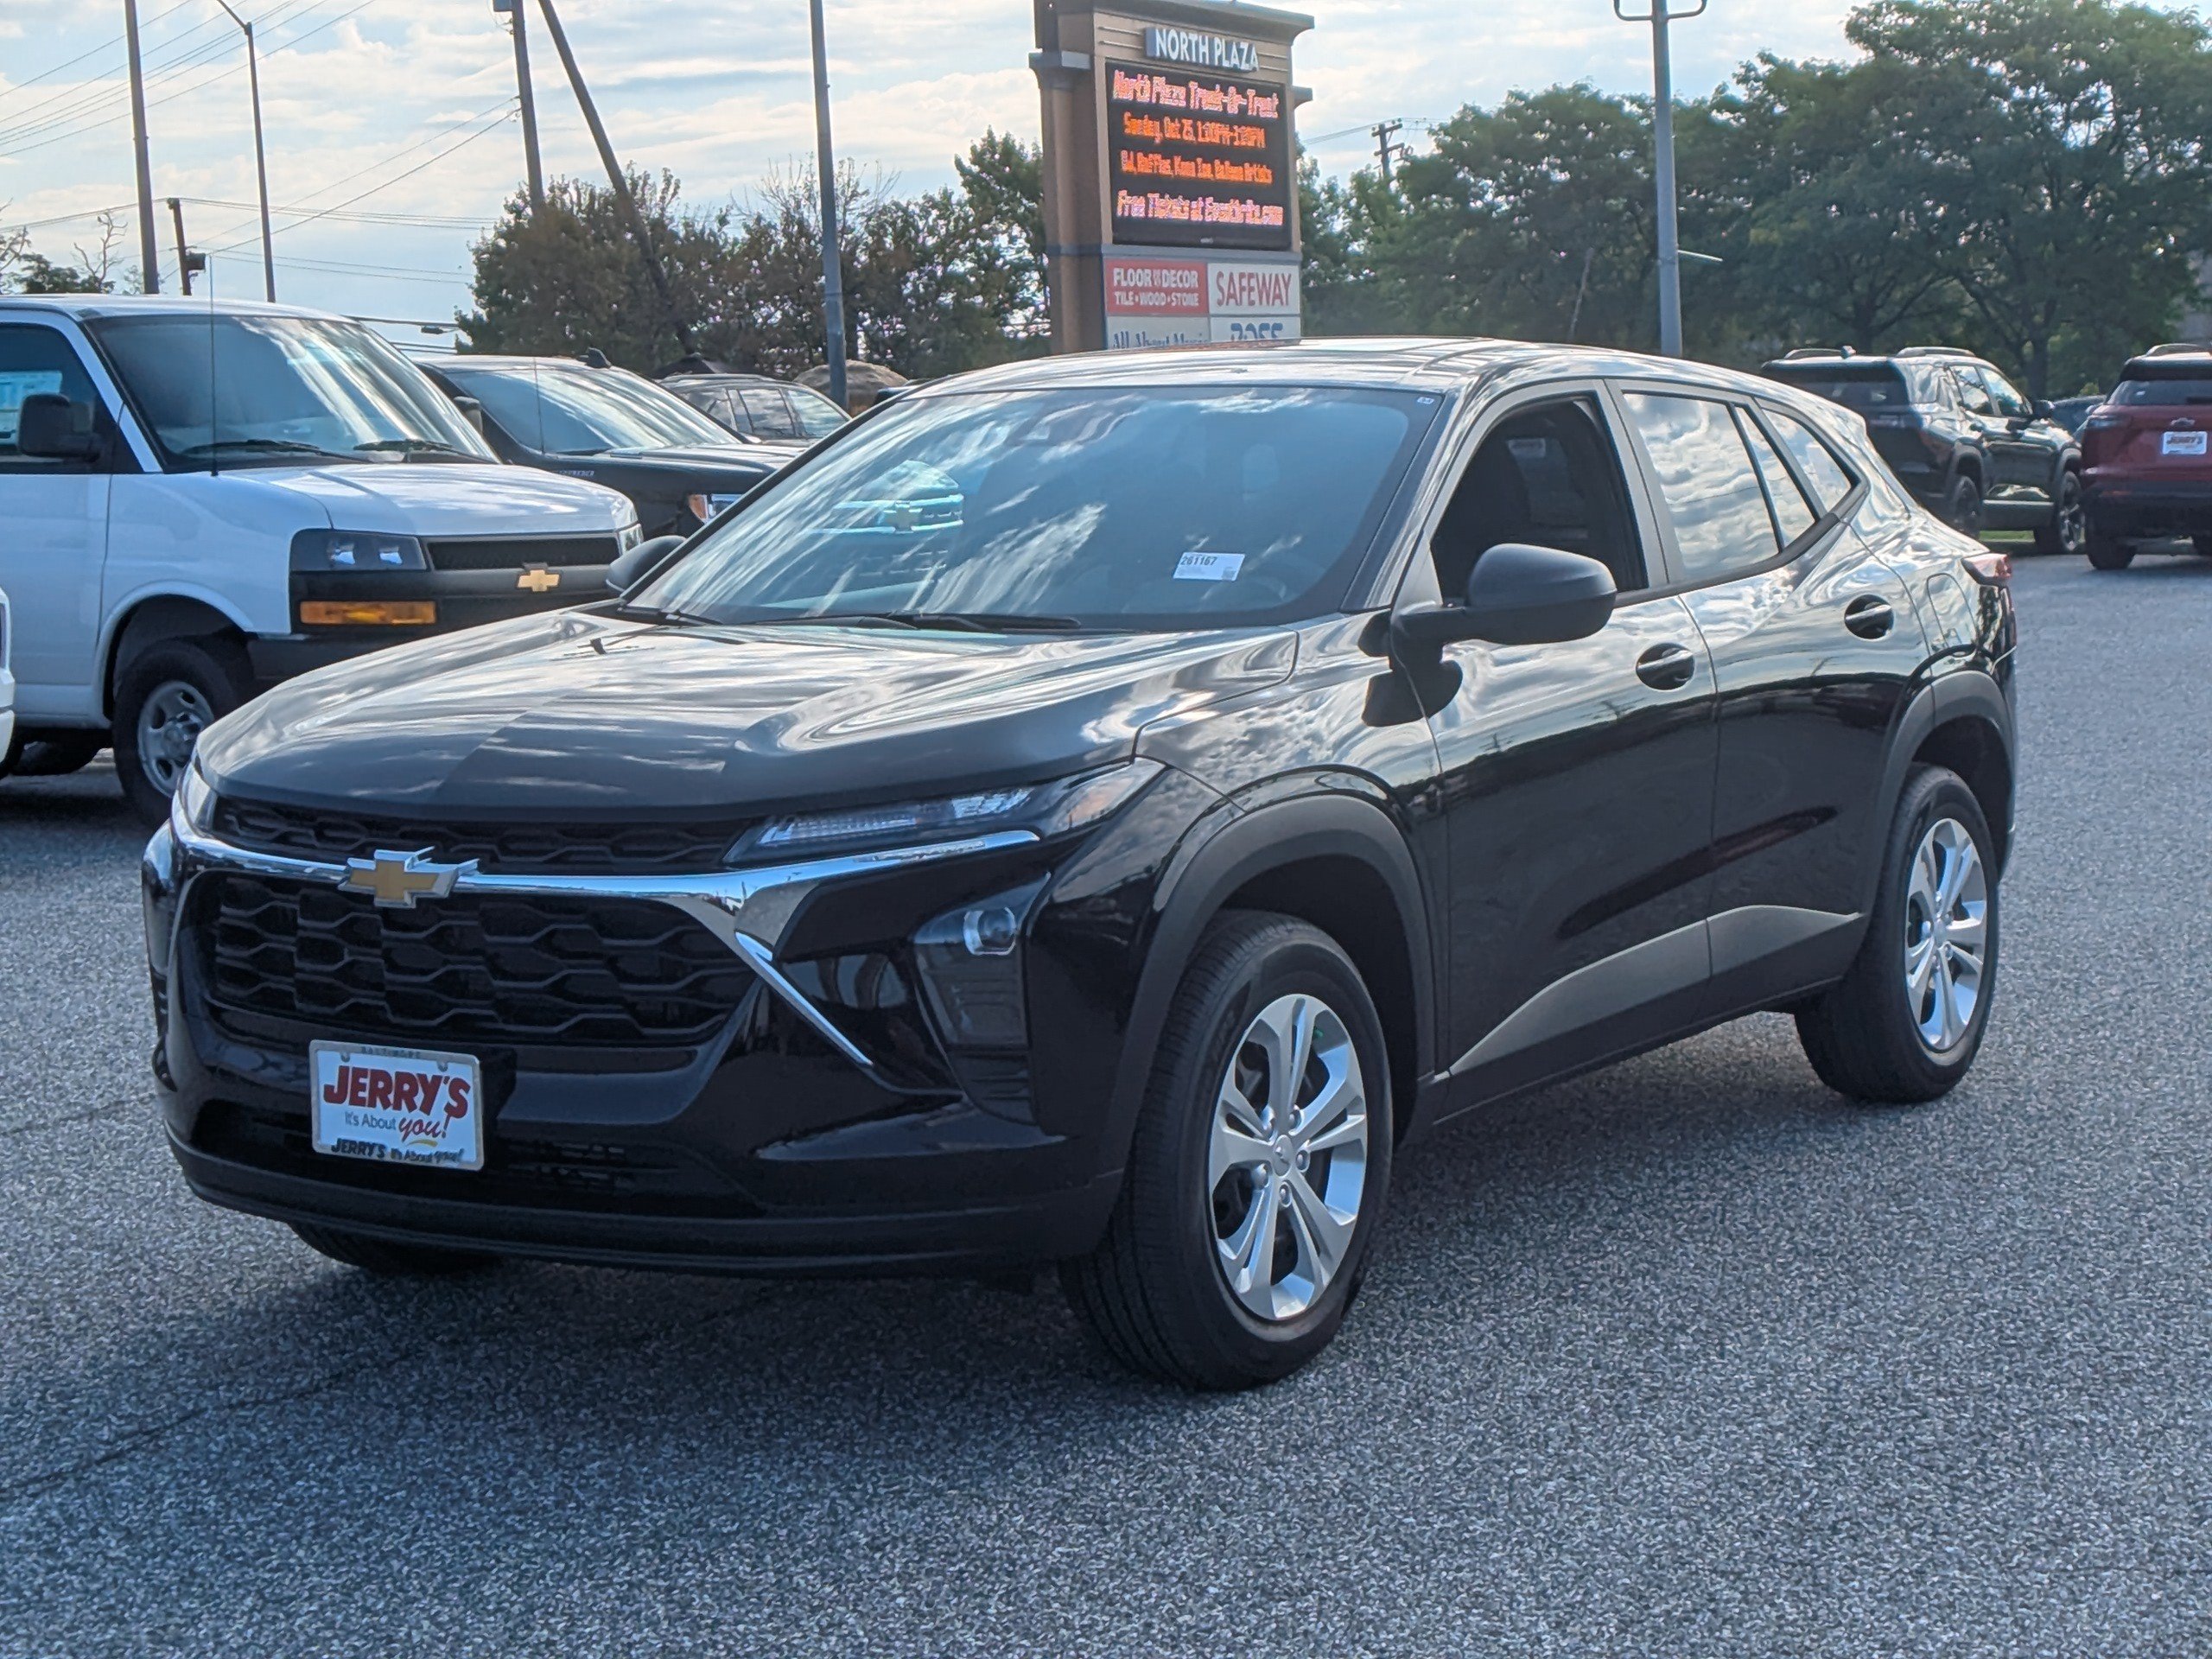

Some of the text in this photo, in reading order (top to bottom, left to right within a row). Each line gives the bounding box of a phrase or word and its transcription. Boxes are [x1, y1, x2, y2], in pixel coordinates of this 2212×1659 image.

[1154, 29, 1260, 71] NORTH PLAZA
[1113, 70, 1152, 102] North
[1152, 76, 1186, 107] Plaza
[1117, 189, 1145, 217] Free
[1147, 193, 1190, 219] Tickets
[1191, 197, 1204, 221] at
[1113, 268, 1152, 288] FLOOR
[1162, 270, 1198, 288] DECOR
[1217, 270, 1292, 307] SAFEWAY
[1114, 291, 1134, 306] TILE
[323, 1065, 471, 1119] JERRY'S
[346, 1111, 453, 1142] It's About you!
[331, 1138, 386, 1159] JERRY'S
